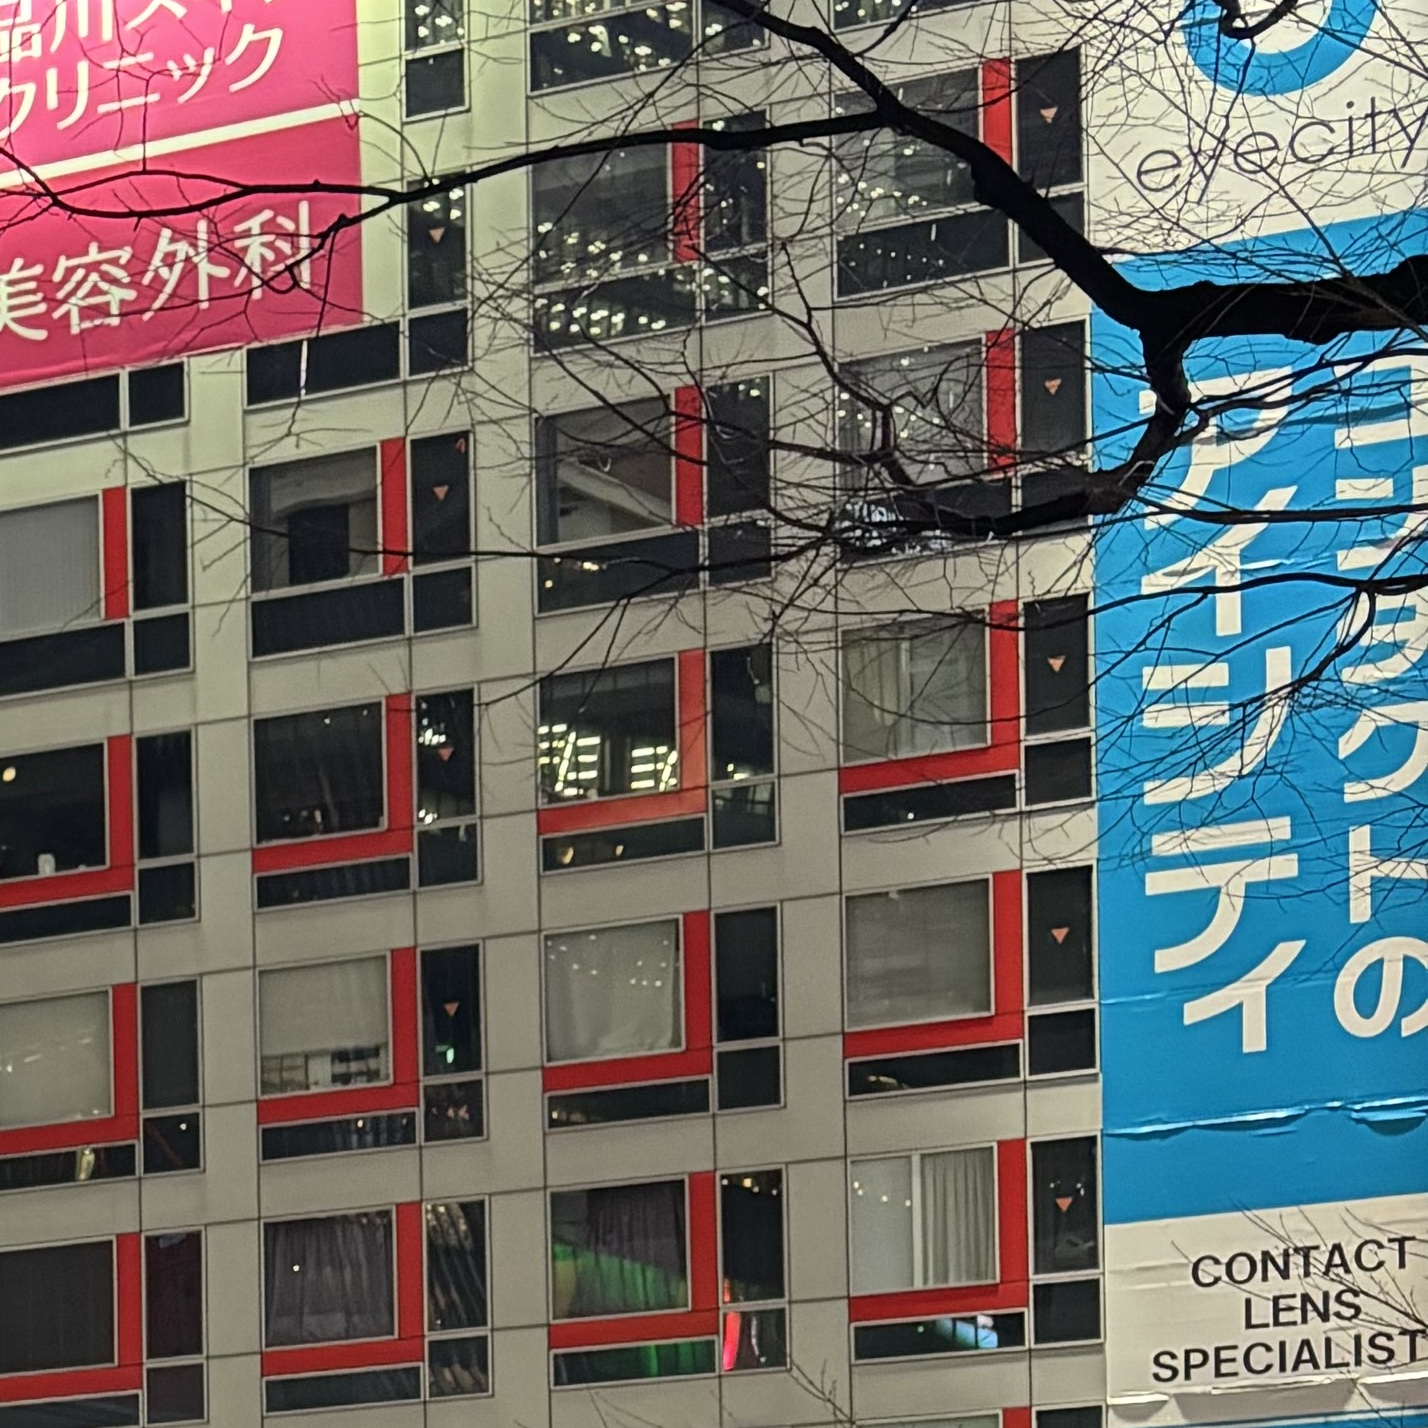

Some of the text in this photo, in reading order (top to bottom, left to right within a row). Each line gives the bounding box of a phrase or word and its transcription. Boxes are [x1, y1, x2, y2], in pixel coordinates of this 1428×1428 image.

[1136, 97, 1428, 204] eyecity
[1191, 1236, 1416, 1288] CONTACT
[1244, 1290, 1363, 1331] LENS
